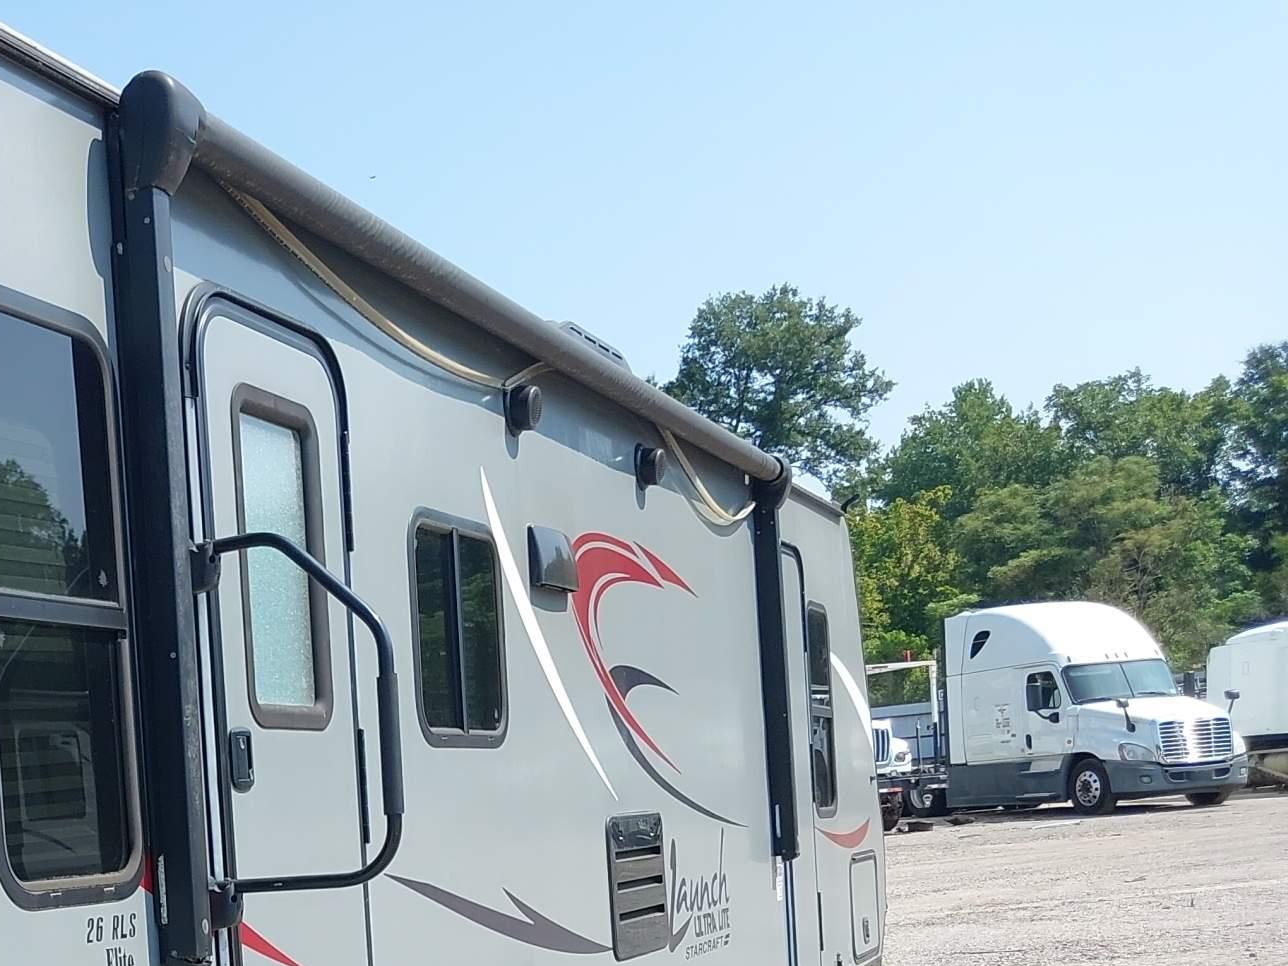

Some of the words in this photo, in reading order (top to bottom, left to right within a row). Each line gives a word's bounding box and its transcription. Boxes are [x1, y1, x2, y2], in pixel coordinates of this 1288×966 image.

[669, 827, 729, 953] Launch
[87, 916, 103, 944] 26
[112, 912, 137, 941] RLS
[693, 911, 718, 938] ULTRA
[718, 907, 731, 931] LITE
[685, 935, 724, 960] STARCRAFT
